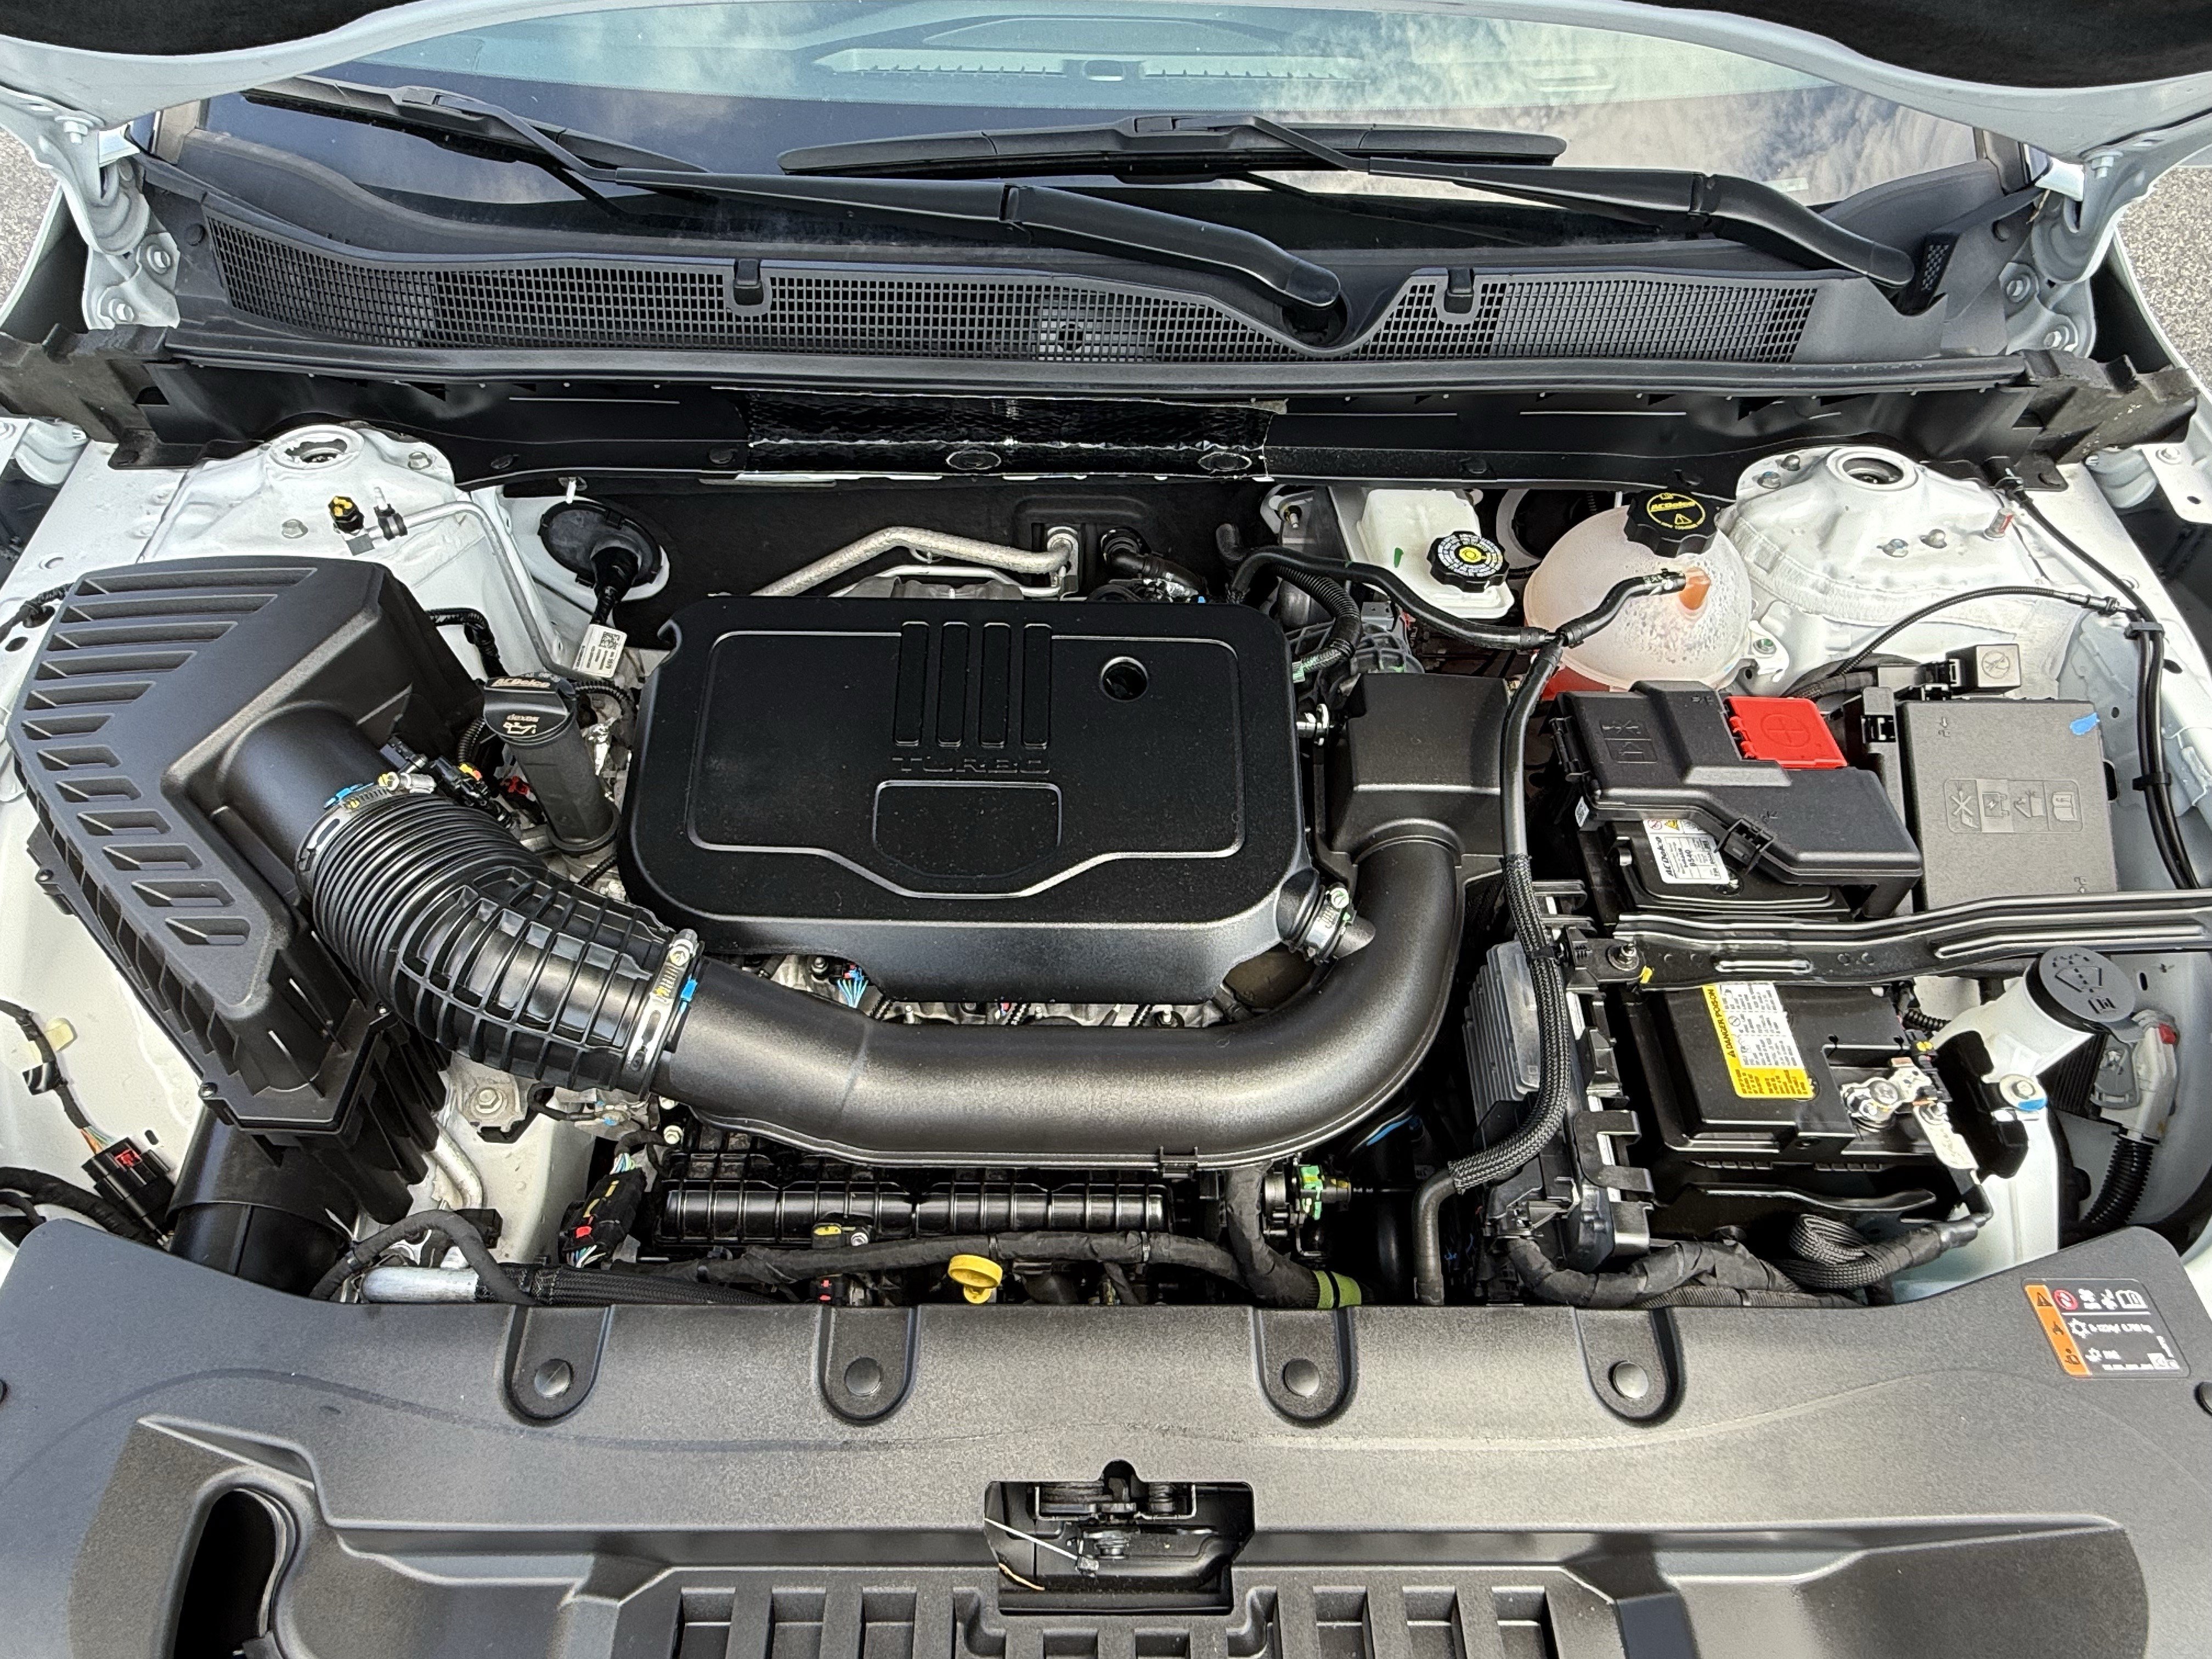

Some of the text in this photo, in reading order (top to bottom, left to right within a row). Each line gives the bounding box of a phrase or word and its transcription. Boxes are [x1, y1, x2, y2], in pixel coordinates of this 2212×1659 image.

[1651, 501, 1696, 511] ACDelco
[491, 678, 551, 688] ACDelco
[891, 756, 1050, 774] TURBO
[1655, 836, 1674, 877] ACDelco
